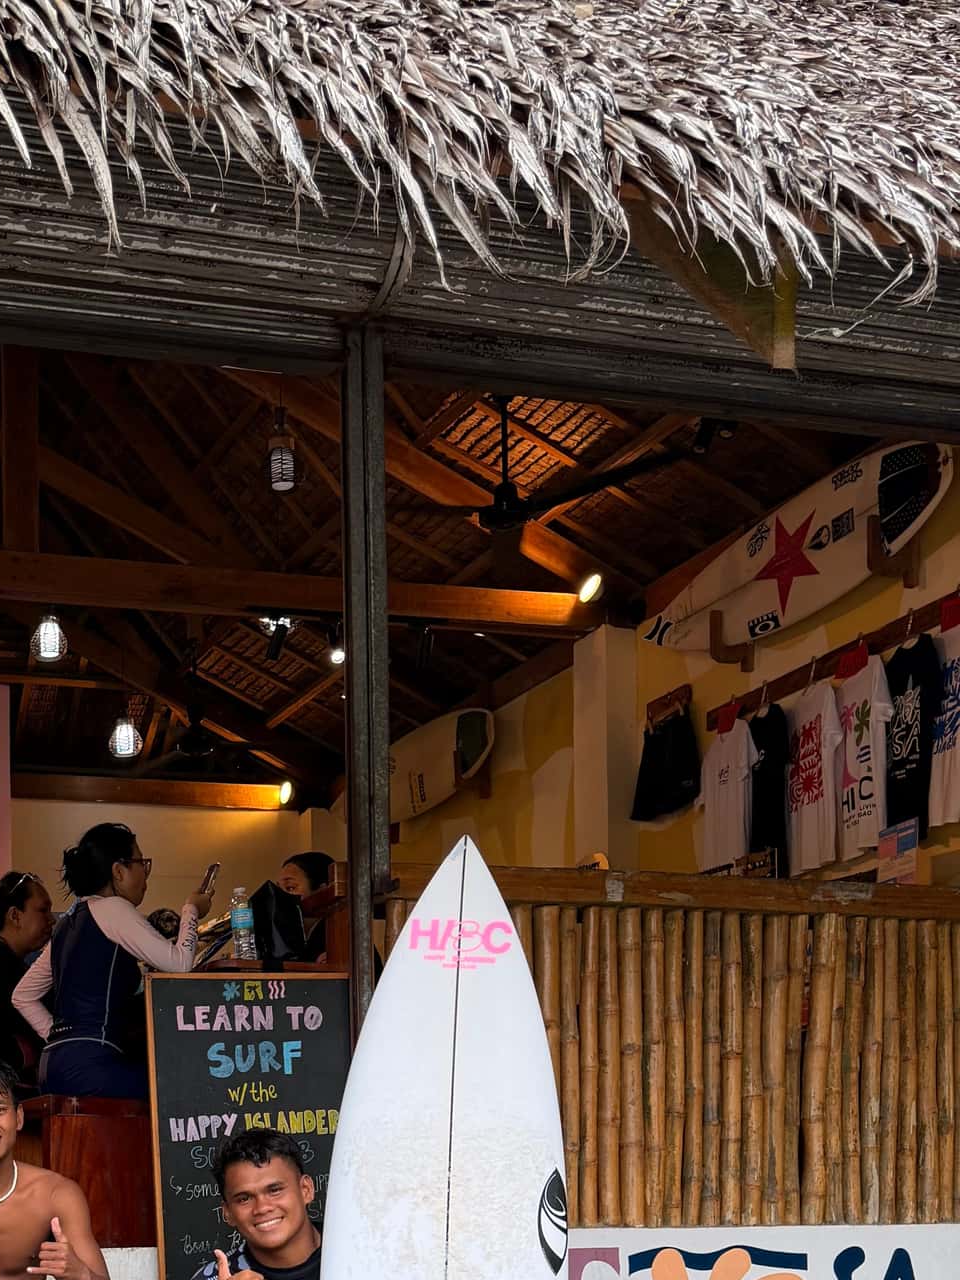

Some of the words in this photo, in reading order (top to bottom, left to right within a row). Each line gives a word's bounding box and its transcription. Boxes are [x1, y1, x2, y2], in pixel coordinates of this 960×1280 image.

[176, 1005, 274, 1031] LEARN
[286, 1005, 323, 1030] TO
[207, 1040, 302, 1078] SURF
[169, 1113, 238, 1142] HAPPY
